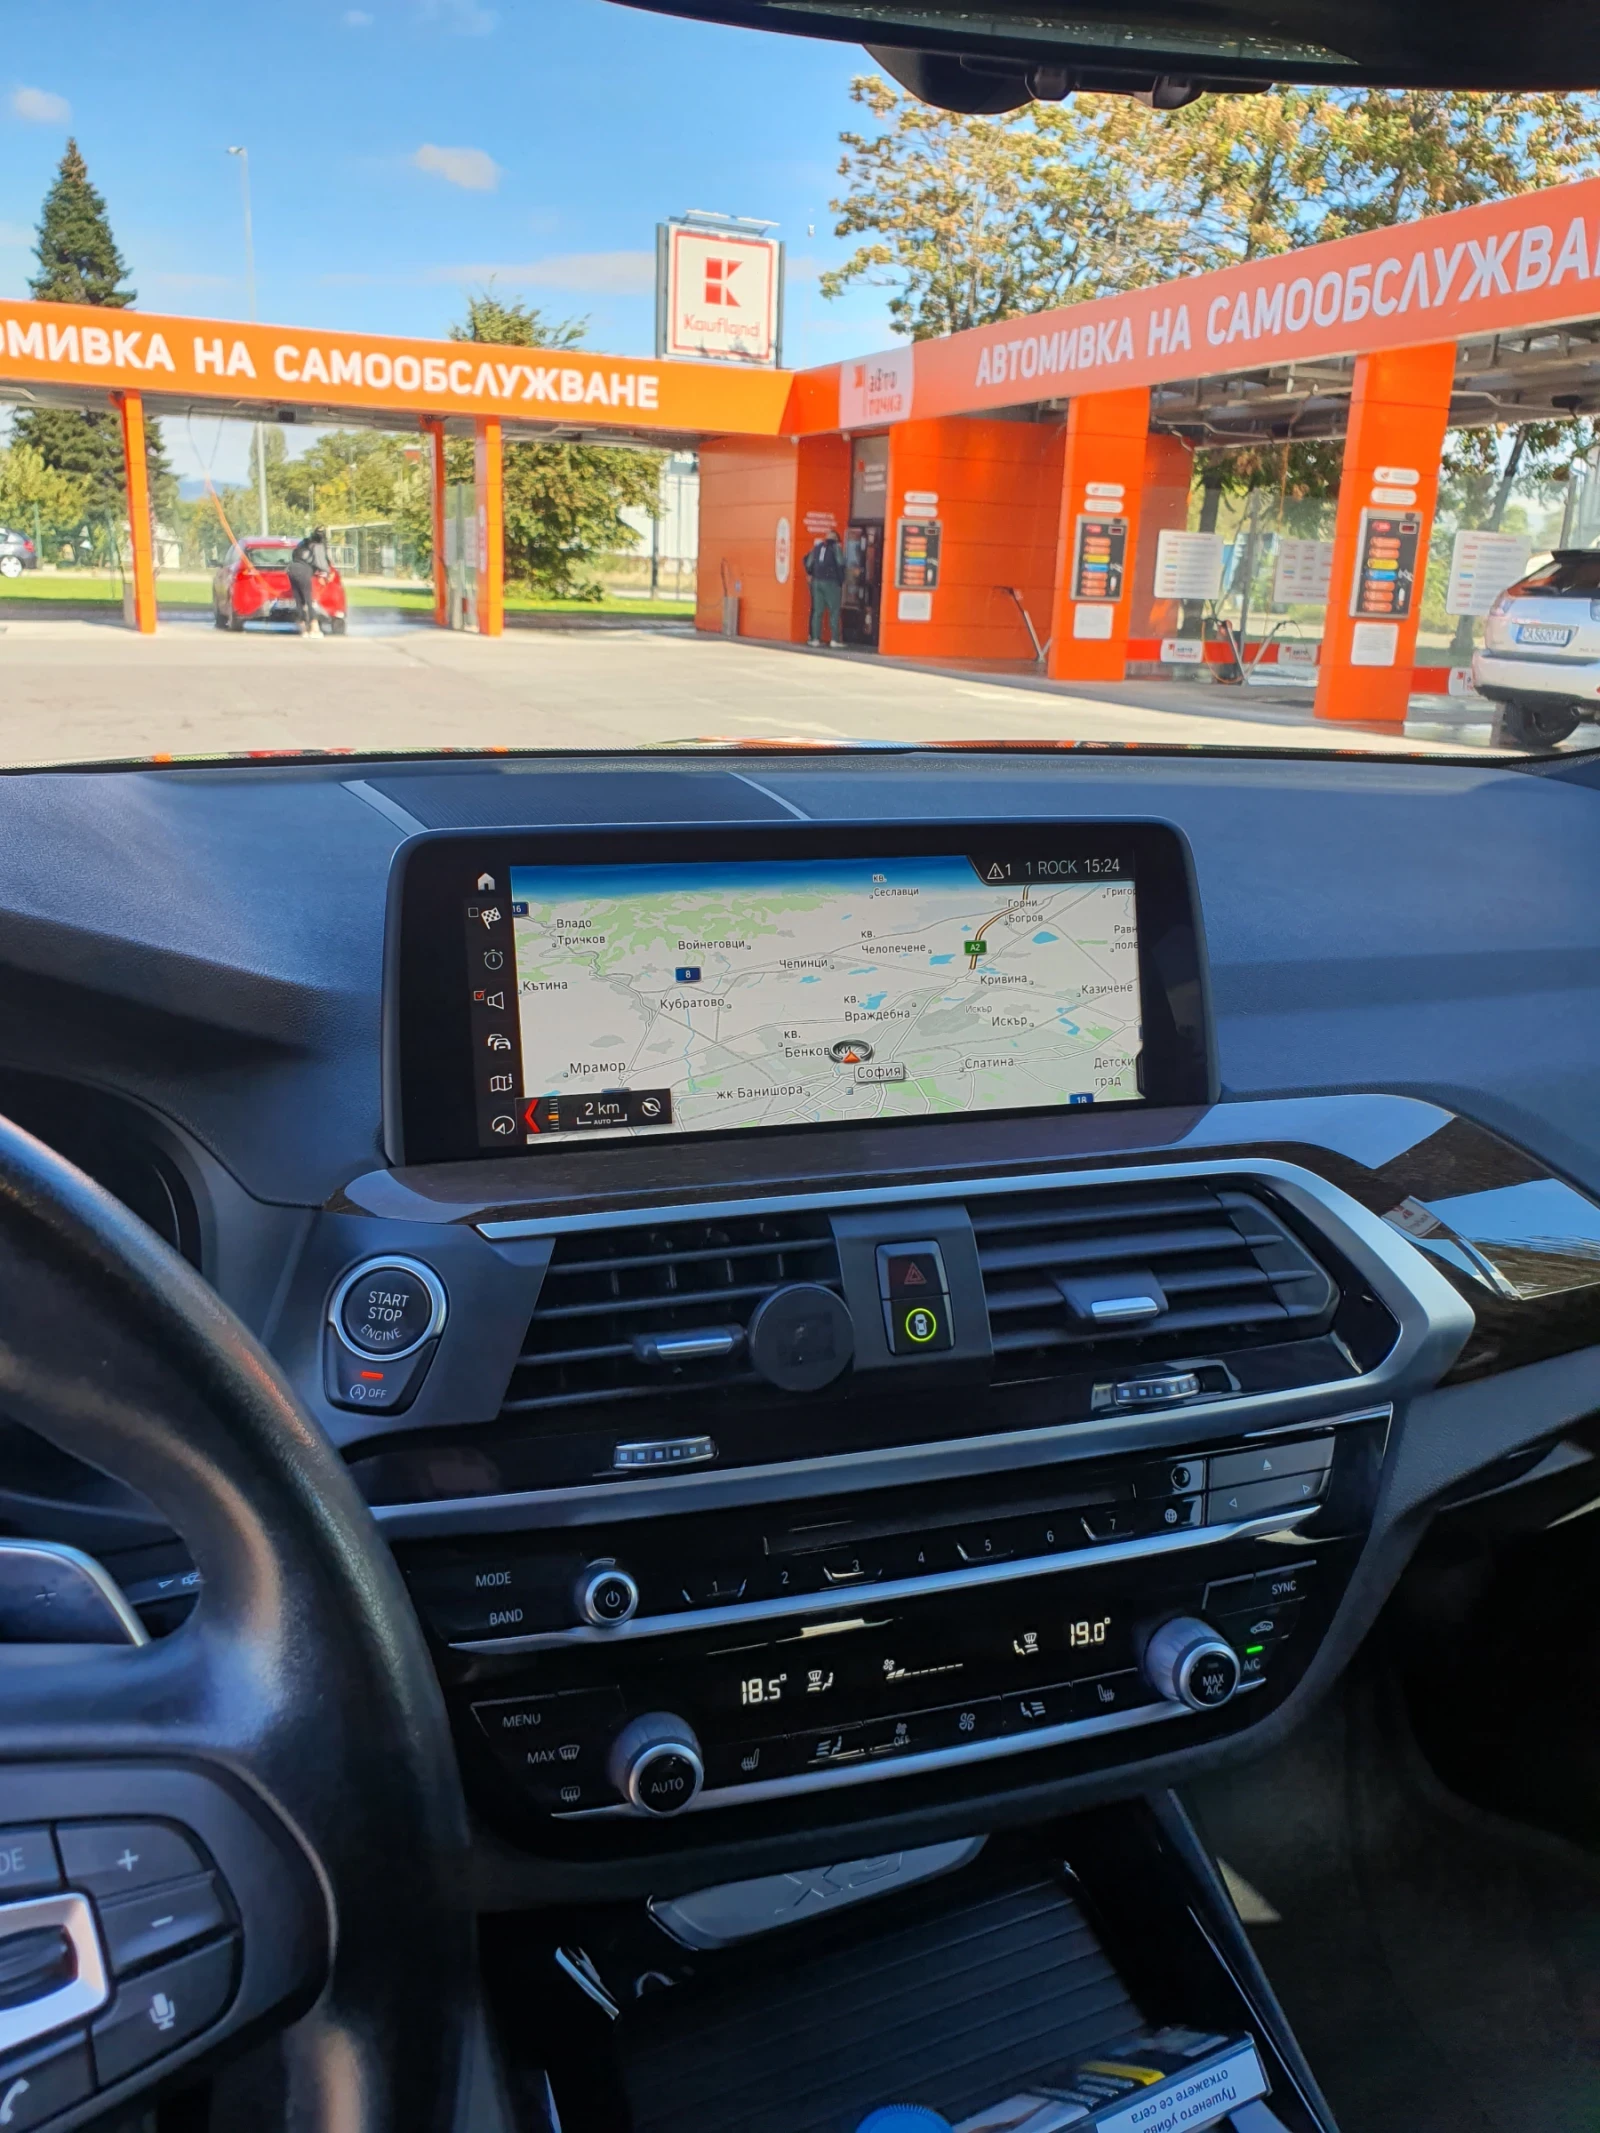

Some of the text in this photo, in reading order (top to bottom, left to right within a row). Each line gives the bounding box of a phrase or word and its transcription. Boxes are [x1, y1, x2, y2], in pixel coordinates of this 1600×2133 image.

[975, 216, 1600, 388] АВТОМИВКА НА САМООБСЛУЖВА
[683, 313, 761, 338] Kaufland
[0, 319, 660, 409] МИВКА НА САМООБСЛУЖВАНЕ
[1025, 860, 1079, 875] 1 ROCK
[1084, 858, 1120, 874] 15:24
[874, 888, 919, 897] Сеславци
[1008, 899, 1038, 909] Горни
[556, 919, 592, 930] Владо
[1008, 914, 1043, 924] Богров
[860, 930, 876, 938] кв.
[557, 936, 606, 947] Тричков
[678, 939, 745, 951] Войнеговци
[970, 943, 981, 951] A2
[861, 943, 926, 955] Челопечене
[779, 959, 828, 970] Чепинци
[685, 970, 691, 978] 8
[980, 974, 1027, 985] Кривина
[523, 980, 568, 991] Кътина
[1081, 983, 1133, 994] Казичене
[660, 997, 725, 1011] Кубратово
[843, 996, 860, 1004] кв.
[844, 1009, 910, 1023] Враждебна
[965, 1005, 993, 1014] Искър
[991, 1016, 1028, 1028] Искър
[784, 1030, 801, 1039] кв.
[785, 1045, 851, 1059] Бенковки
[569, 1062, 626, 1076] Мрамор
[964, 1057, 1014, 1070] Слатина
[1094, 1057, 1134, 1070] Детски
[857, 1066, 901, 1081] София
[1095, 1076, 1121, 1088] град
[716, 1084, 803, 1100] жк Банишора
[585, 1102, 620, 1115] 2 km
[368, 1291, 410, 1308] START
[368, 1306, 403, 1322] STOP
[360, 1323, 402, 1341] ENGINE
[368, 1388, 387, 1398] OFF
[781, 1571, 790, 1584] 2
[852, 1560, 860, 1572] 3
[917, 1550, 926, 1564] 4
[984, 1539, 993, 1552] 5
[1046, 1530, 1055, 1543] 6
[1109, 1518, 1117, 1530] 7
[475, 1571, 512, 1587] MODE
[1271, 1580, 1297, 1595] SYNC
[489, 1608, 523, 1626] BAND
[1243, 1658, 1261, 1672] A/C
[1202, 1673, 1225, 1687] MAX
[1205, 1684, 1222, 1696] A/C
[502, 1713, 542, 1728] MENU
[527, 1750, 556, 1764] MAX
[651, 1777, 684, 1794] AUTO
[1131, 2069, 1229, 2124] откажете се сега
[1180, 2086, 1237, 2120] Пушенето
